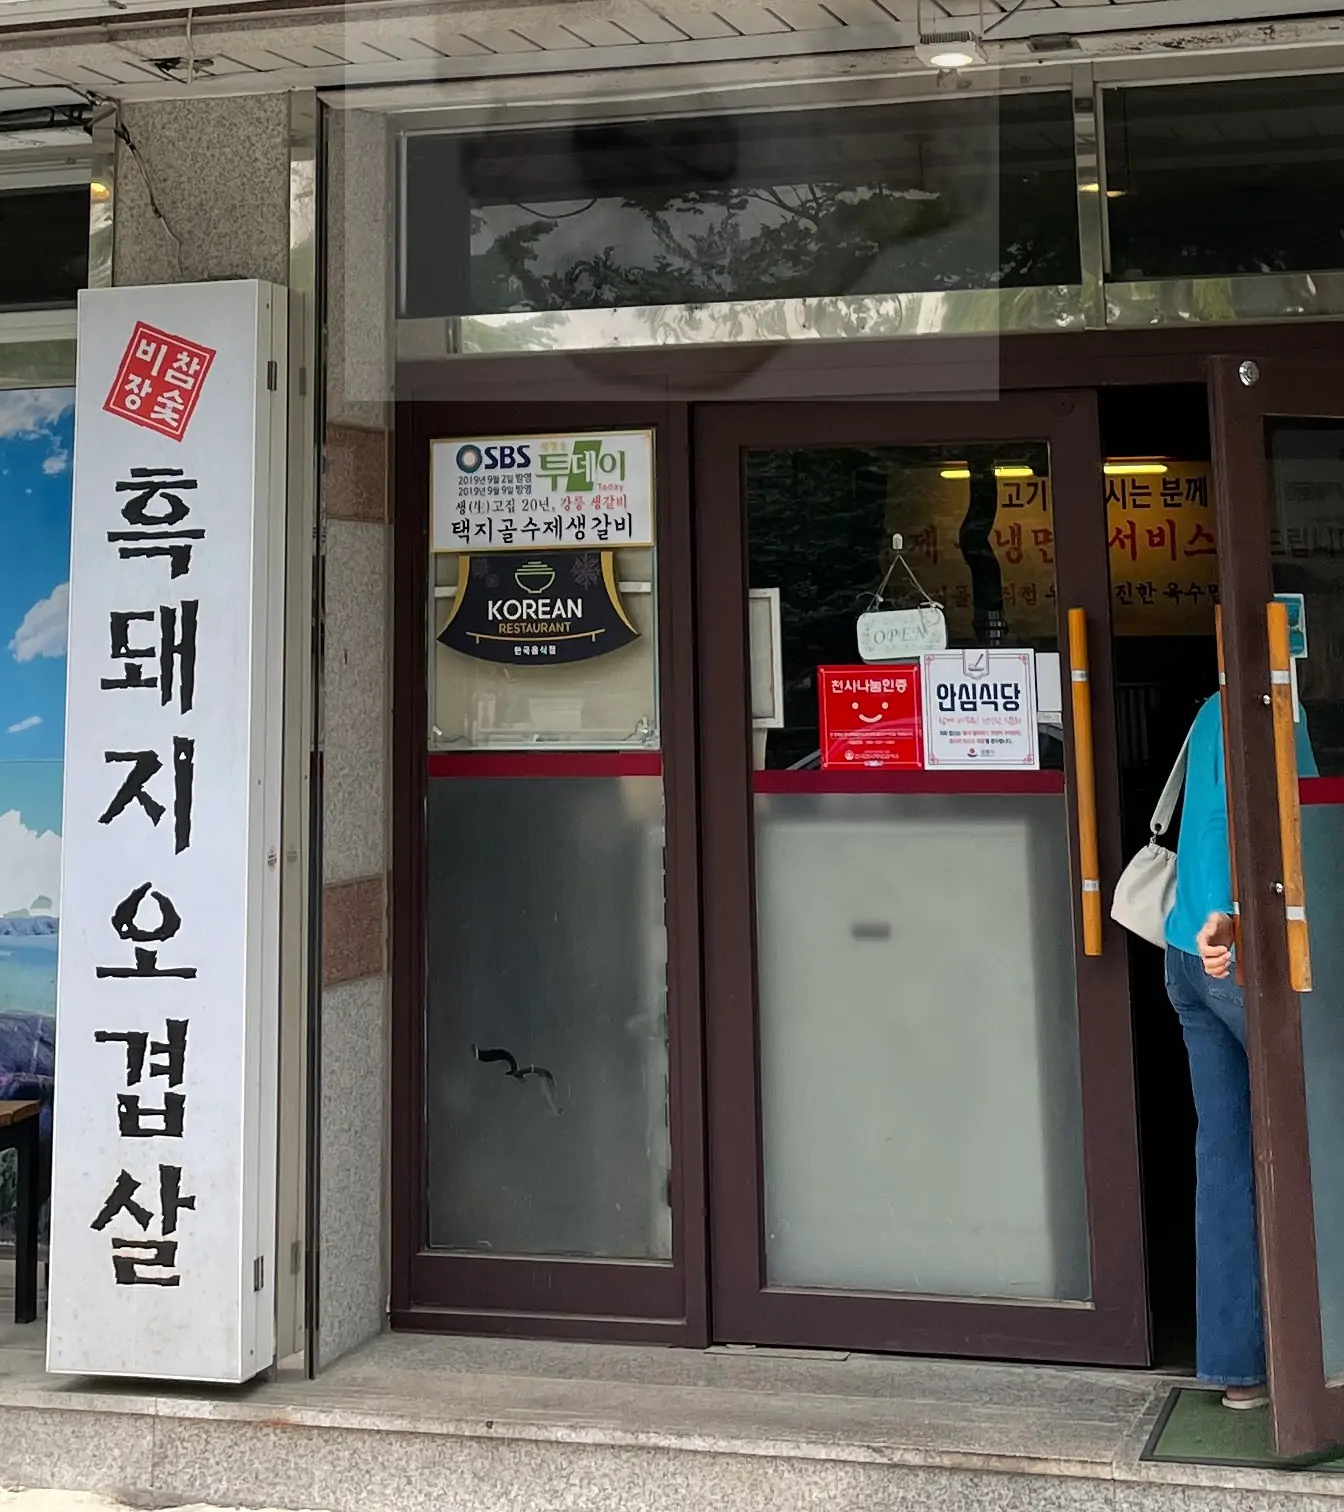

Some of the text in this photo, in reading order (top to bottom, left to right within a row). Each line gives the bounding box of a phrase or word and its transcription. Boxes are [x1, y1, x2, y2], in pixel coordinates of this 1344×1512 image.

[484, 445, 531, 469] SBS
[458, 475, 485, 485] 2019년
[535, 450, 625, 492] 투데이
[458, 486, 485, 496] 2019년
[597, 482, 624, 491] Today
[451, 512, 632, 544] 택지골수제생갈비
[1108, 519, 1217, 564] 서비스
[488, 598, 582, 620] KOREAN
[498, 621, 572, 634] RESTAURANT
[873, 625, 928, 645] OPEN
[936, 683, 1021, 712] 안심식당
